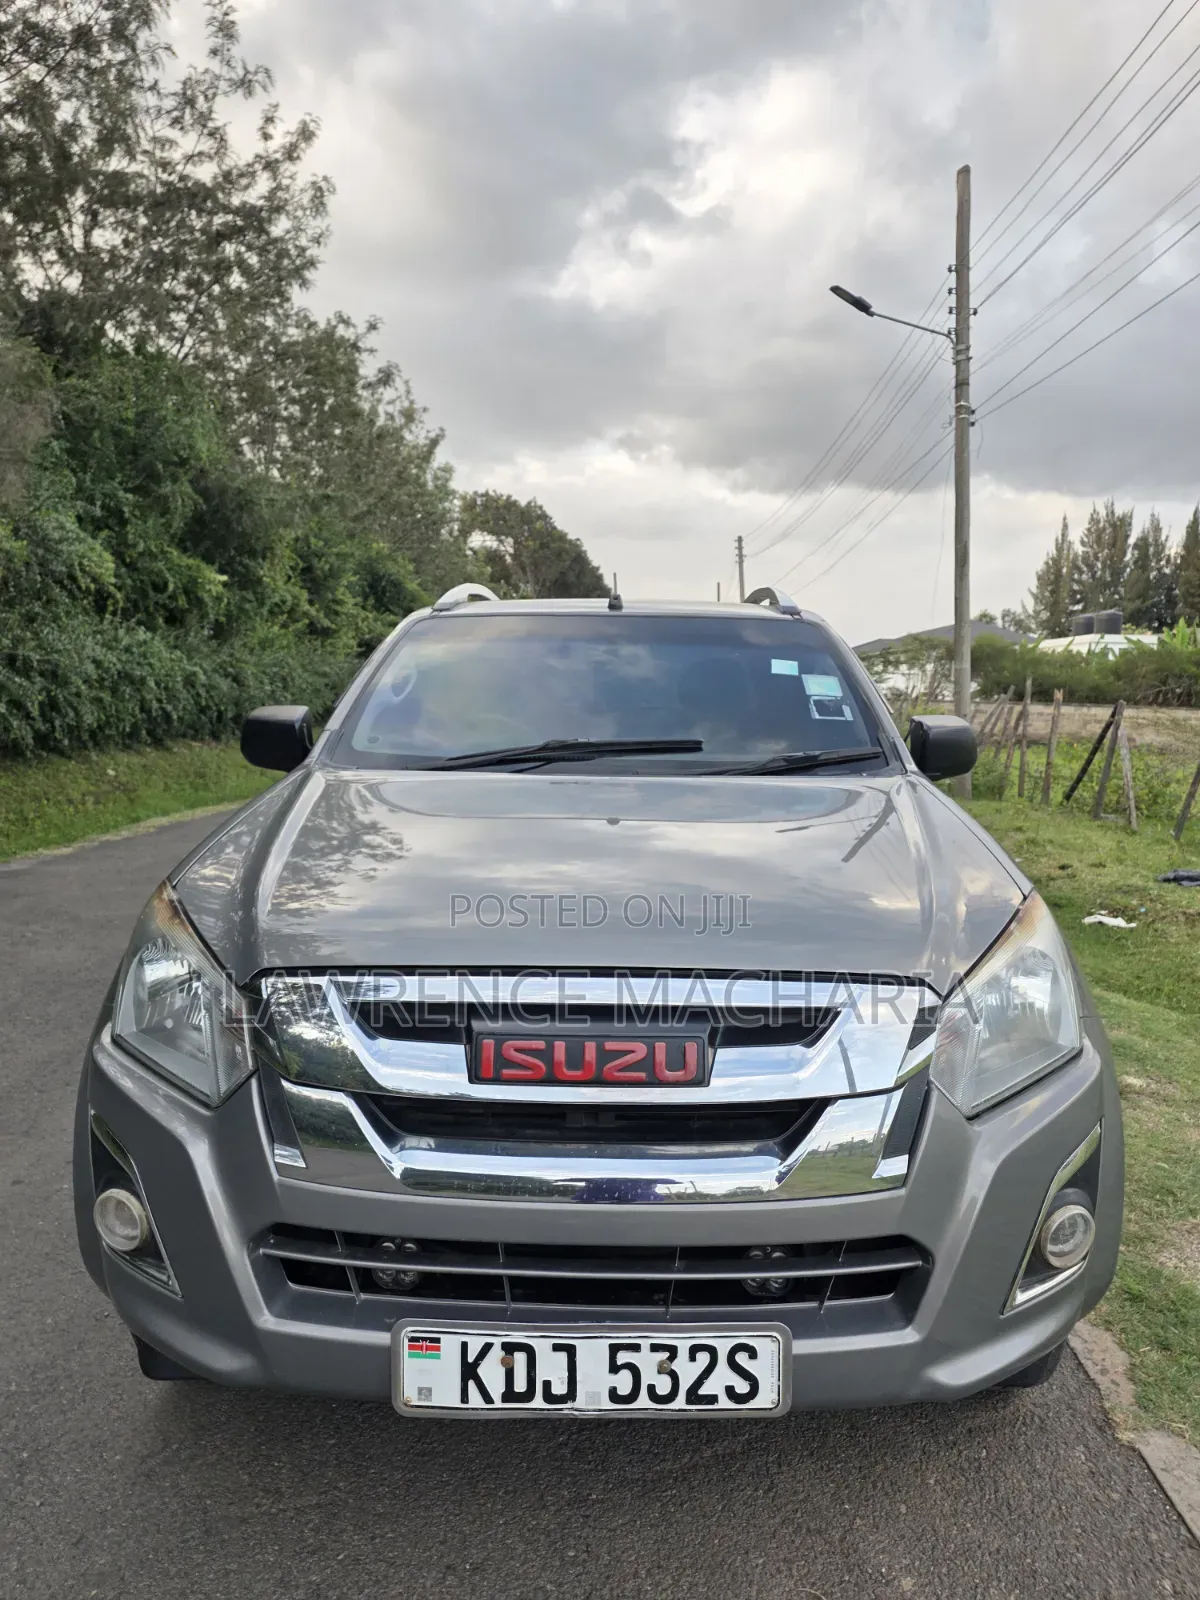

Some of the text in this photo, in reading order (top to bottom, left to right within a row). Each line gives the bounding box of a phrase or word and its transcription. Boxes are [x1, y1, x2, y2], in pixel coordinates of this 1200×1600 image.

[480, 1038, 698, 1082] ISUZU
[460, 1340, 577, 1405] KDJ
[608, 1341, 760, 1405] 532S
